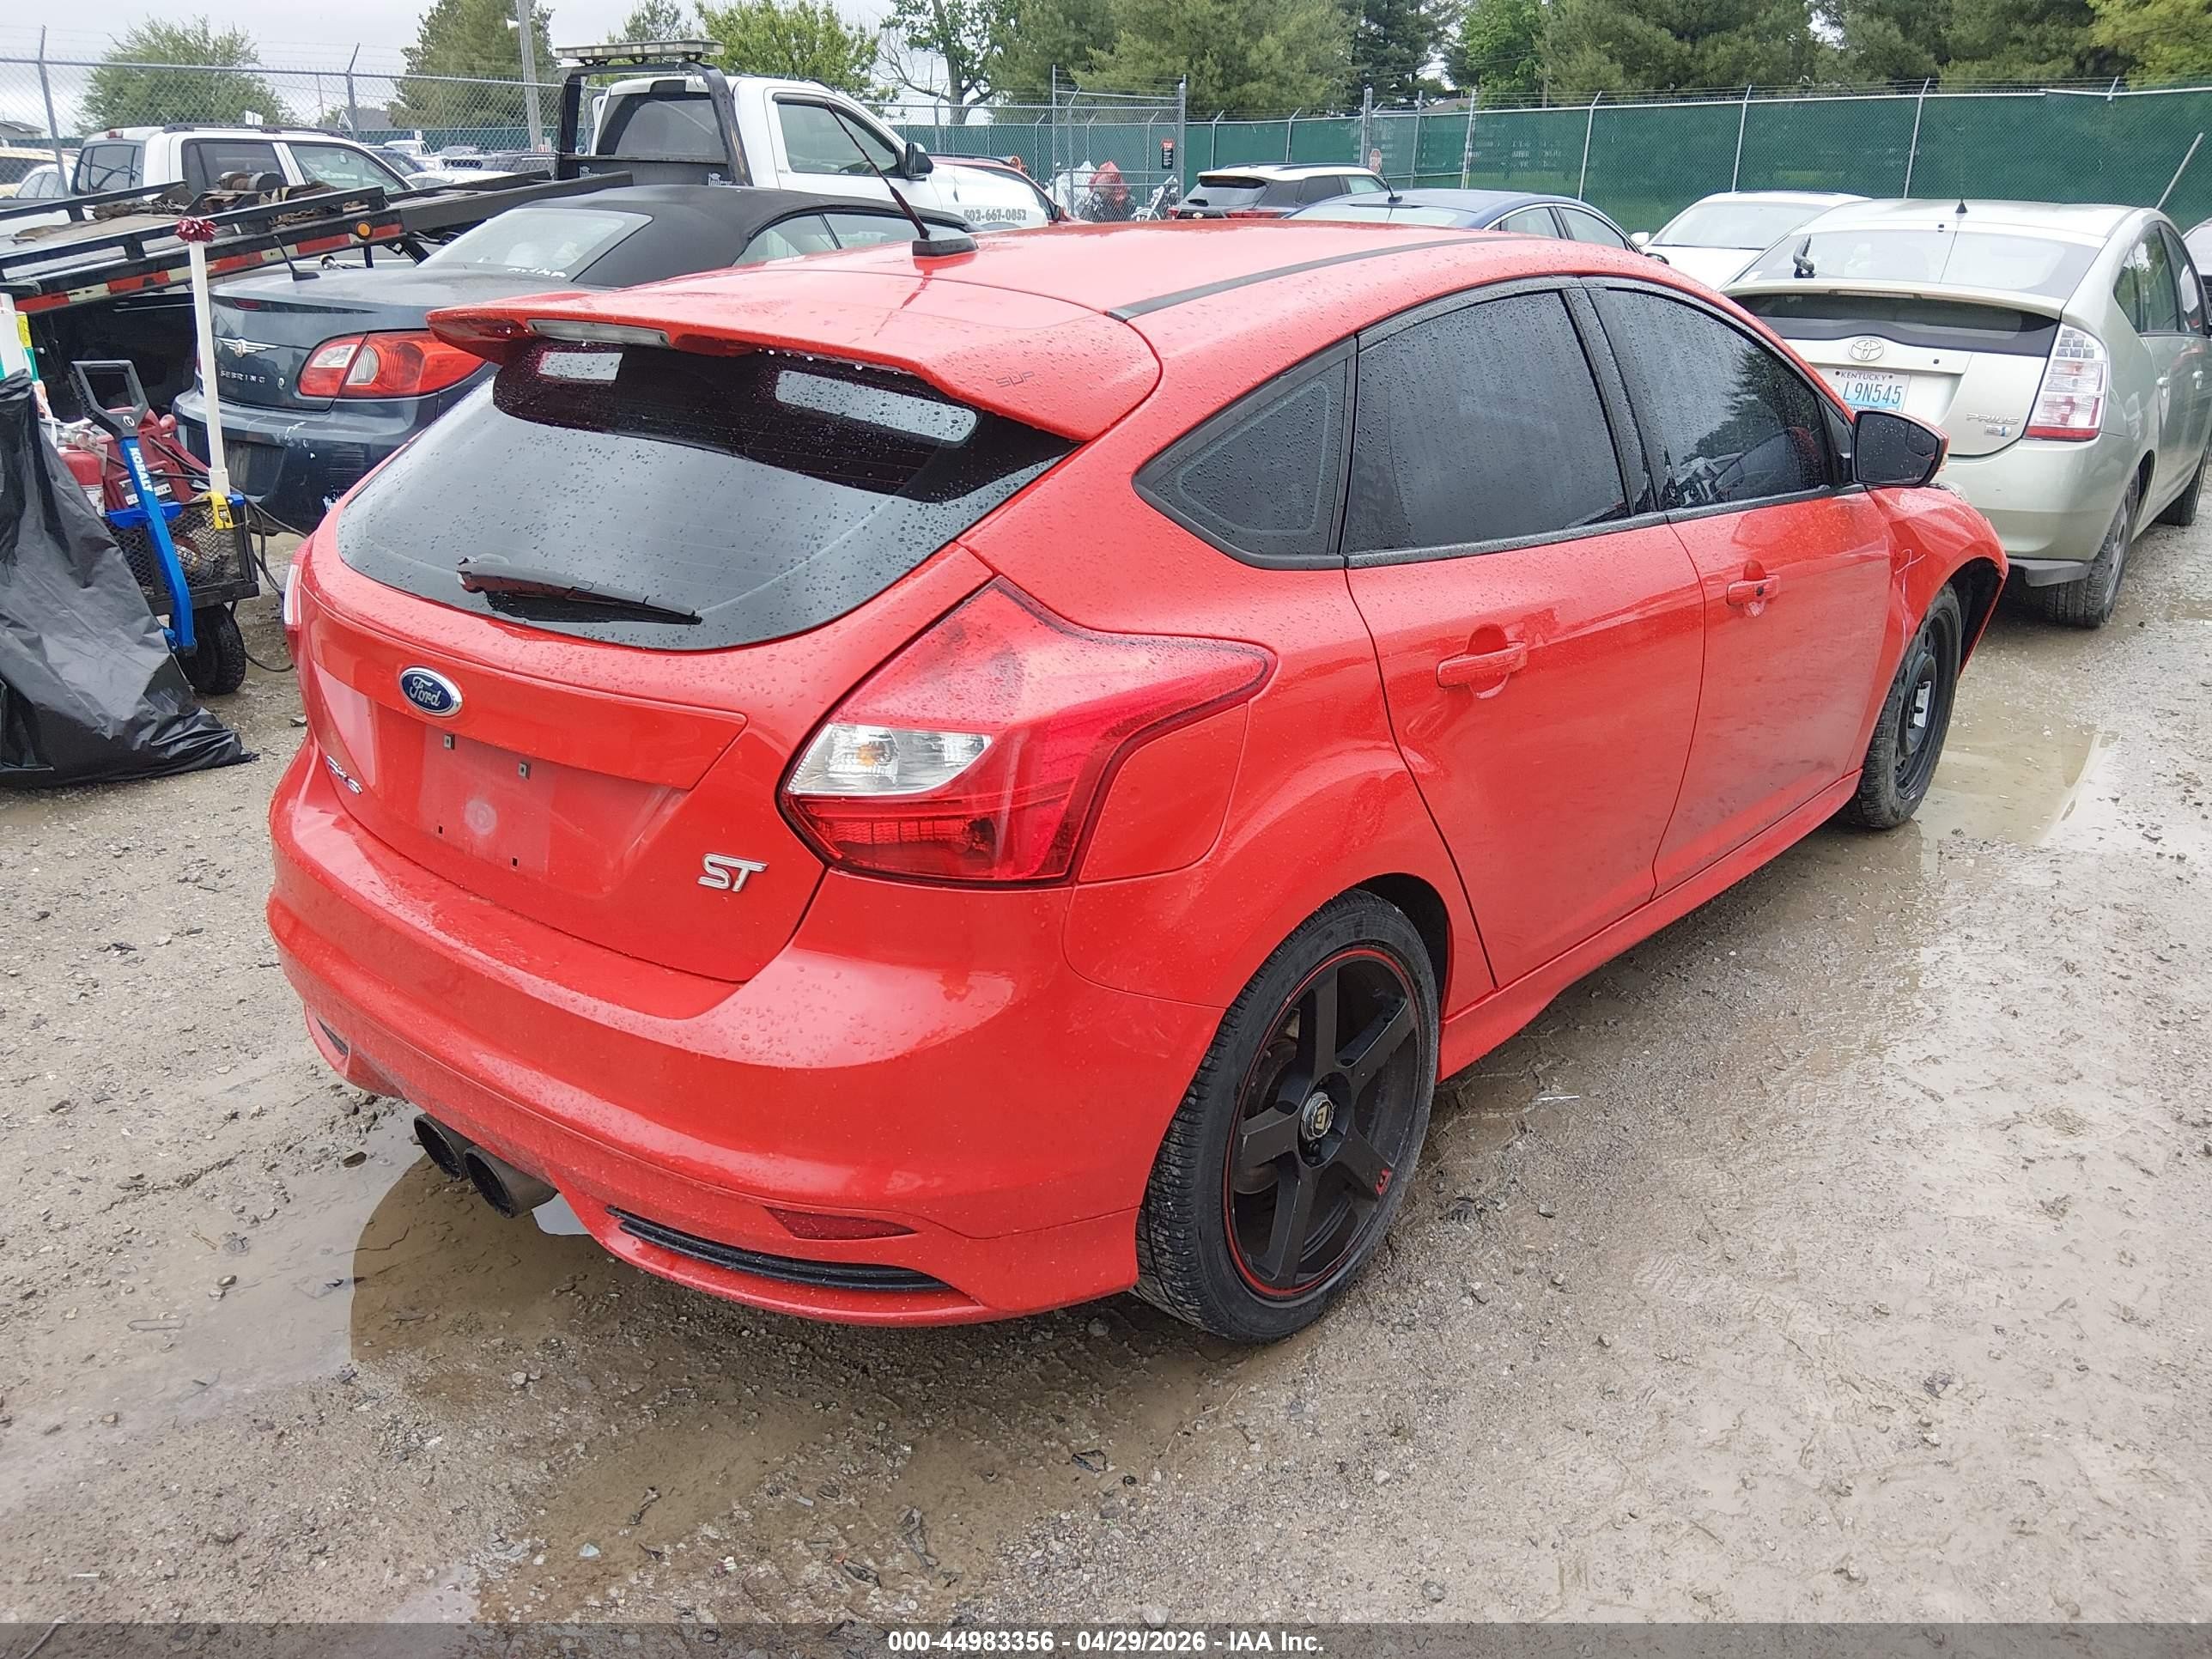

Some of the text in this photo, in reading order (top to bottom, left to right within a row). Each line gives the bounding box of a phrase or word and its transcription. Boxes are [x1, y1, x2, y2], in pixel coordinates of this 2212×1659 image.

[963, 208, 1027, 222] 502-667-0852
[220, 371, 265, 383] SEBRING
[1840, 371, 1887, 380] KENTUCKY
[1843, 381, 1904, 404] L9N545
[1966, 412, 2020, 425] PRIUS
[129, 447, 155, 492] KOBALT
[409, 676, 442, 707] Ford
[697, 853, 769, 892] ST
